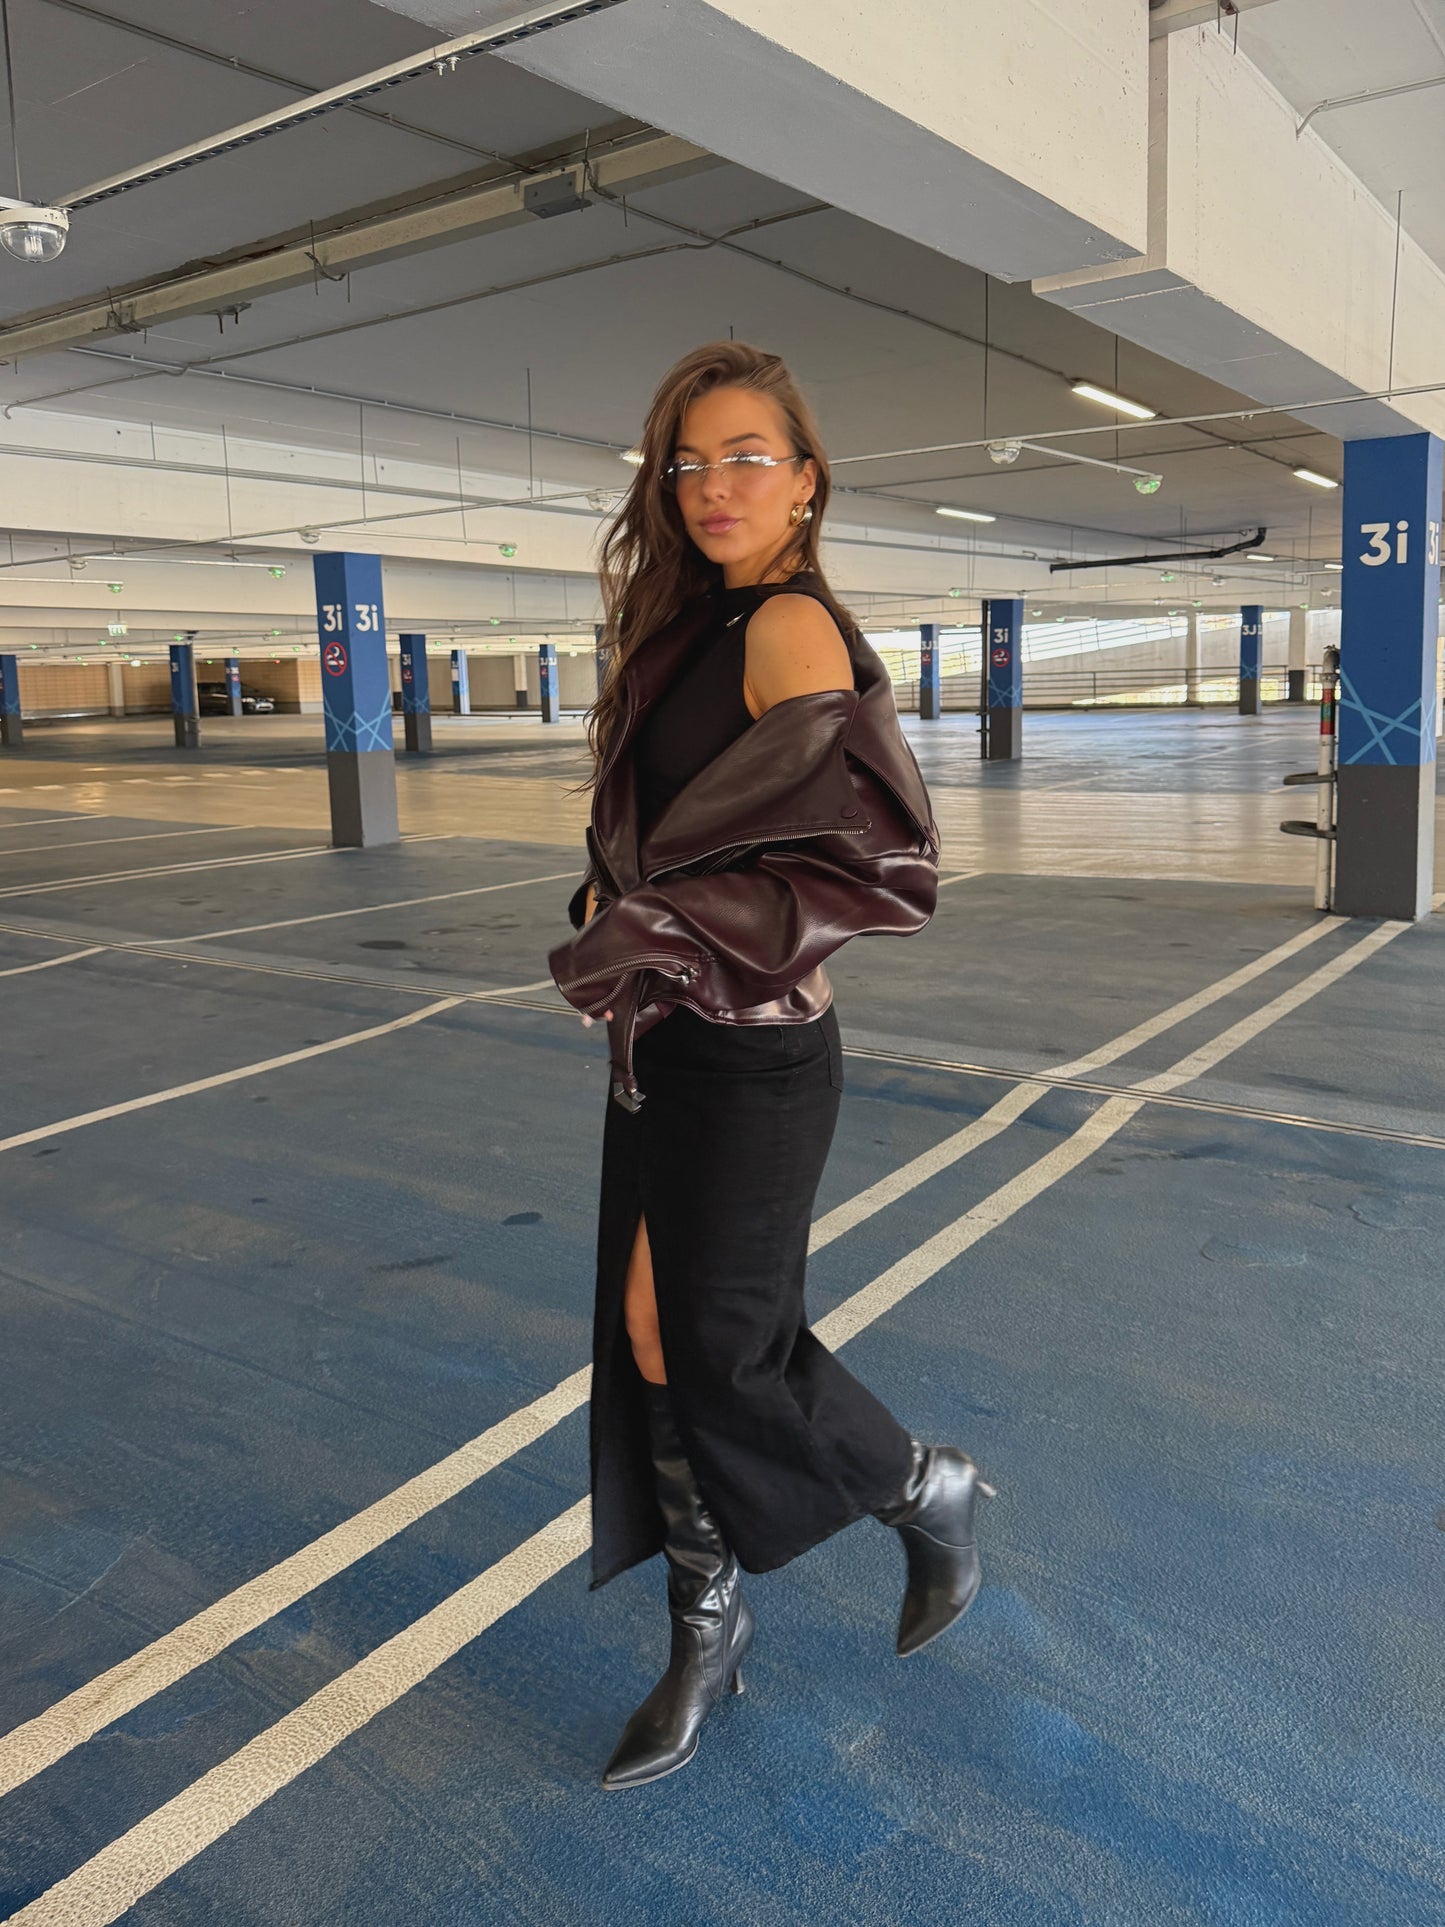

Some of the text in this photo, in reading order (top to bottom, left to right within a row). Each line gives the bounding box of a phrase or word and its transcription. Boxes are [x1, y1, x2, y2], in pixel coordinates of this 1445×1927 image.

[1359, 520, 1409, 567] 3i
[1428, 521, 1440, 566] 3i
[322, 604, 343, 632] 3i
[355, 604, 379, 632] 3i
[993, 628, 1009, 643] 3i
